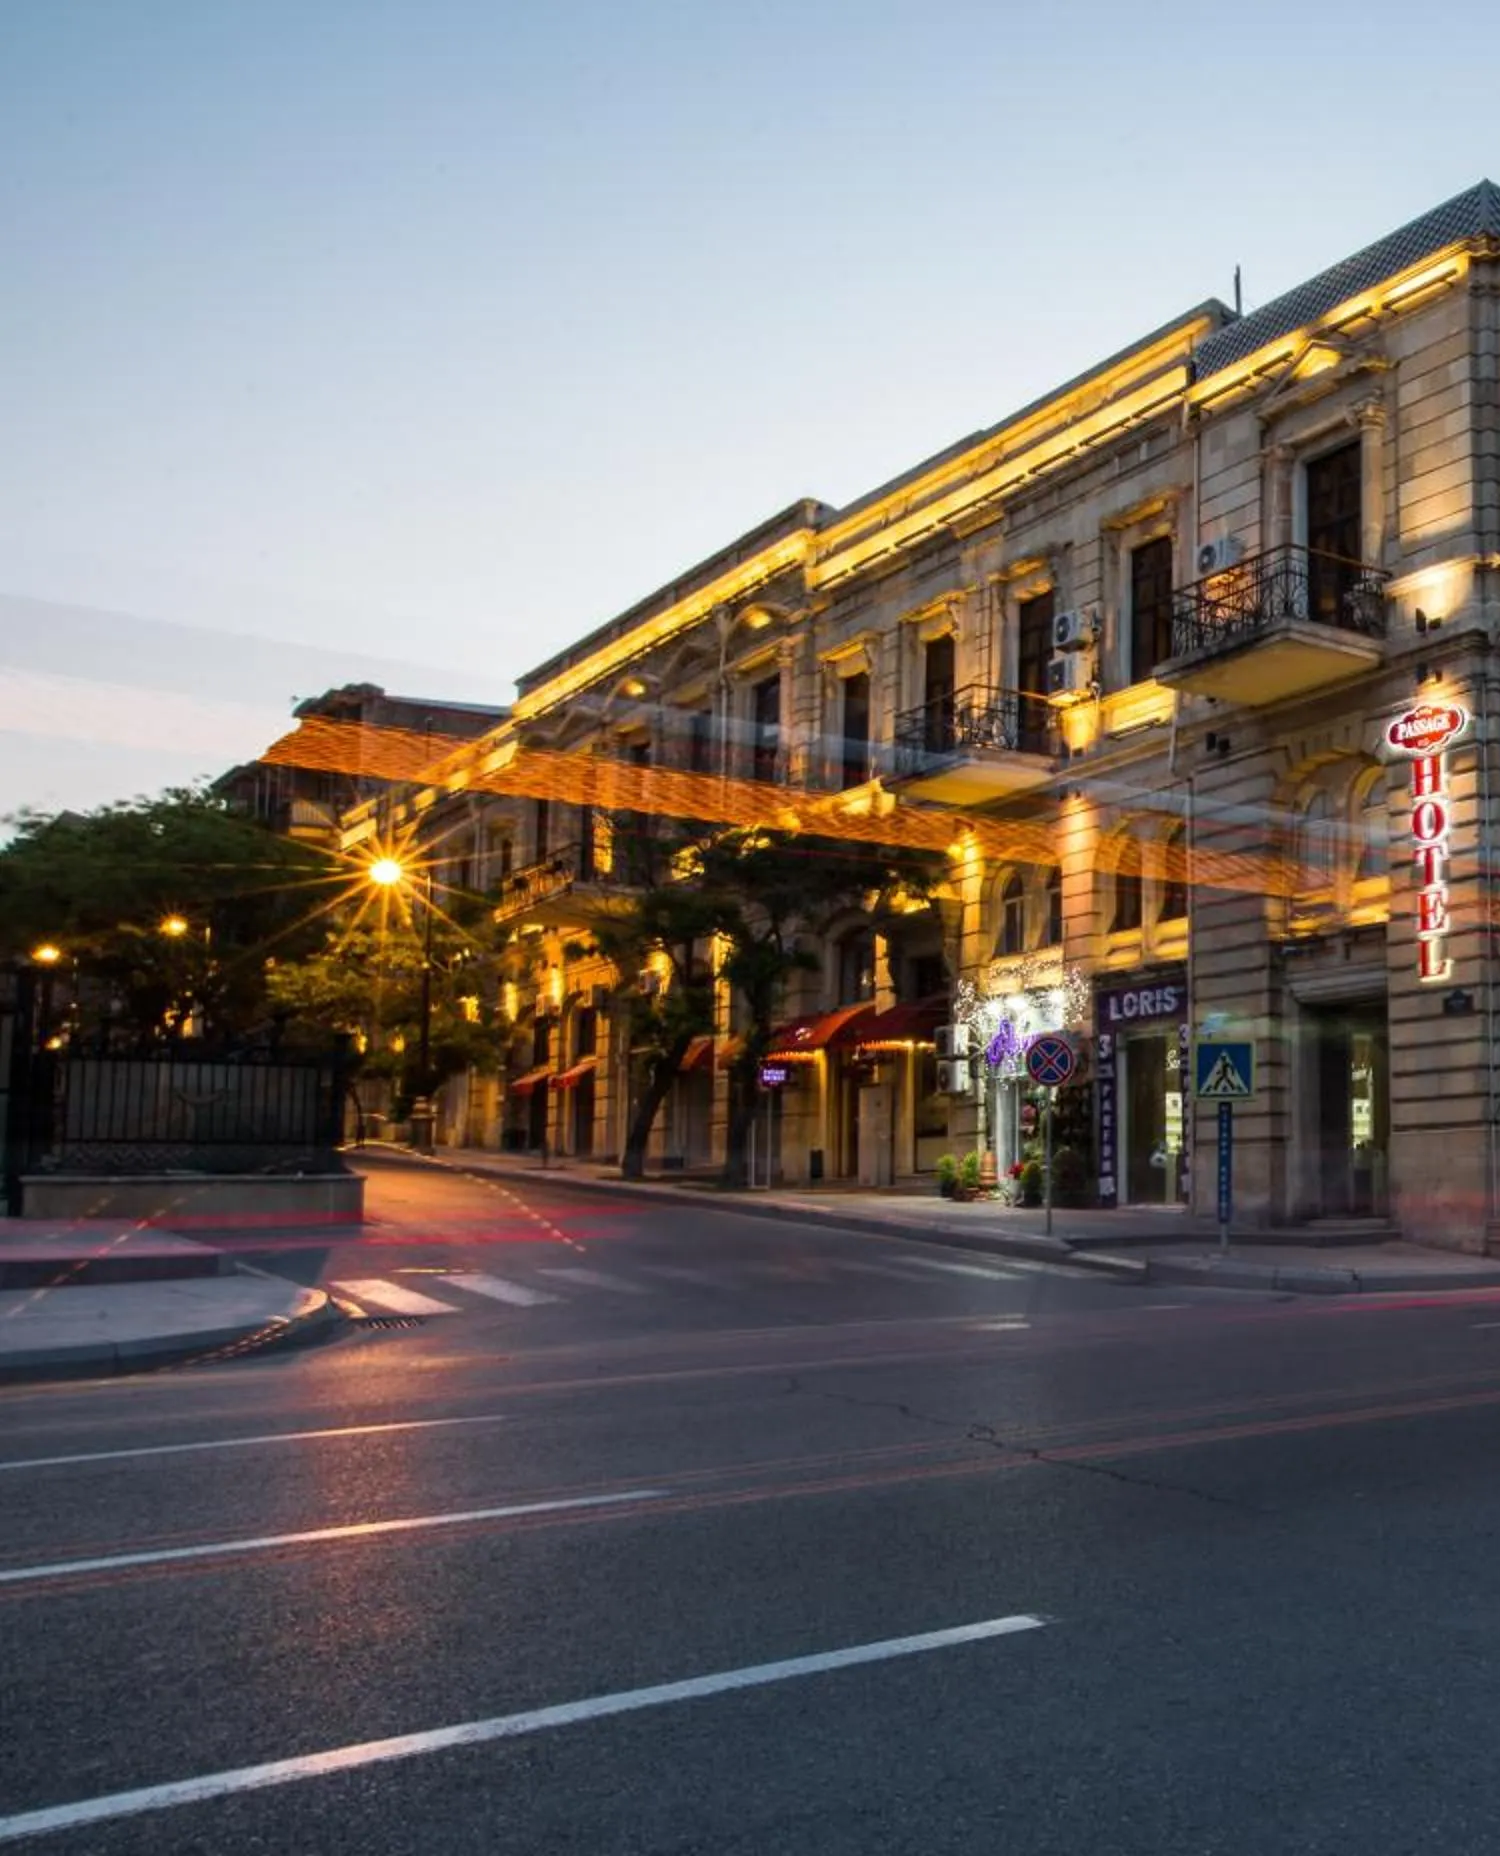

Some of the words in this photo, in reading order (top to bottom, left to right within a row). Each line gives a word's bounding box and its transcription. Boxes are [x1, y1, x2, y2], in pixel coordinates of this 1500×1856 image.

[1411, 754, 1452, 981] HOTEL
[1109, 986, 1178, 1020] LORIS
[1099, 1034, 1112, 1058] 3
